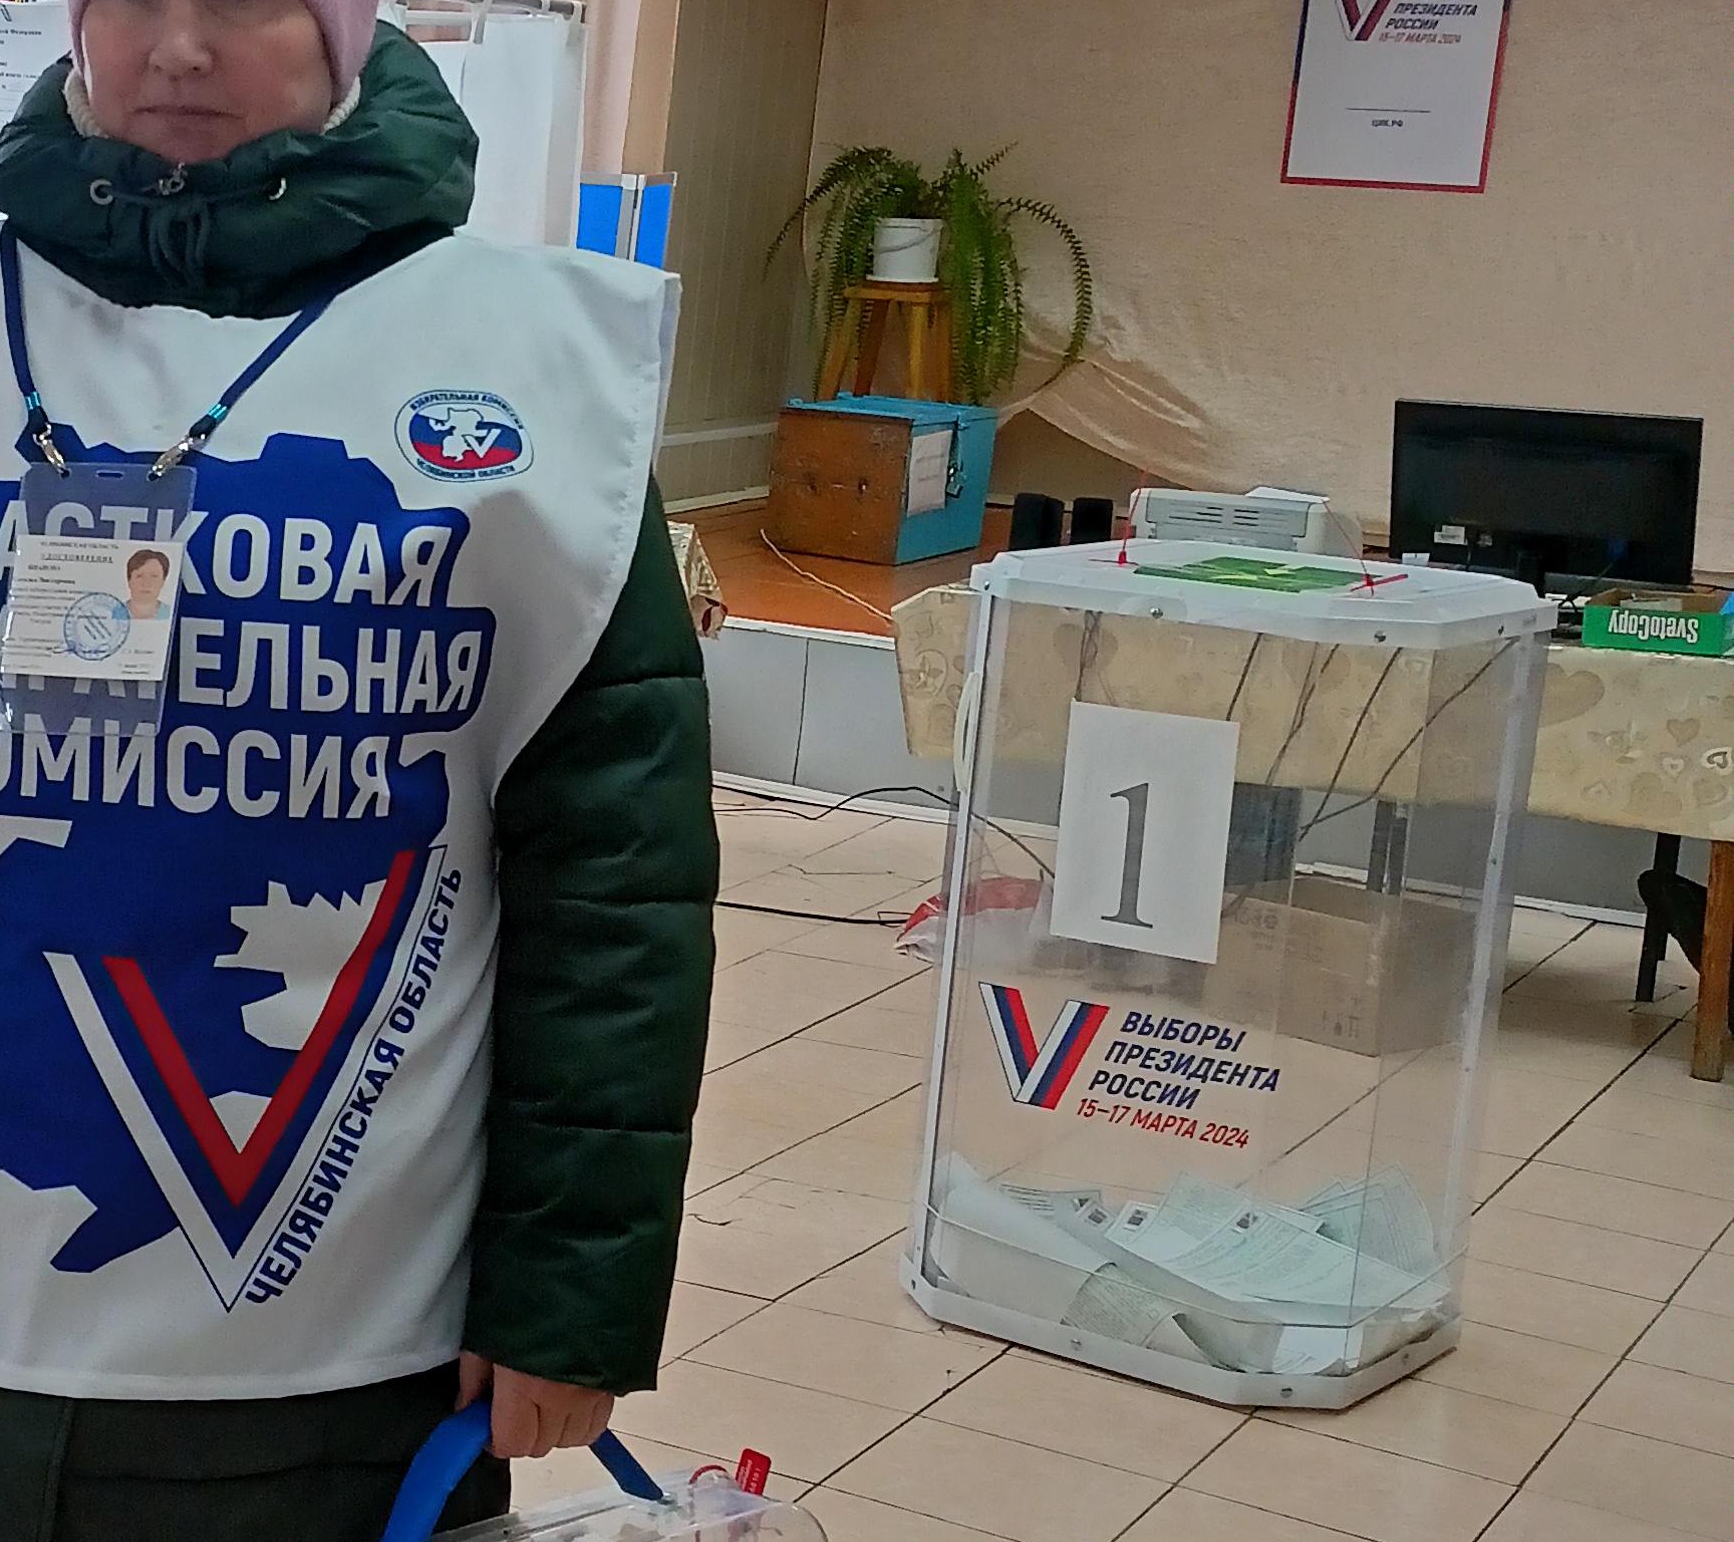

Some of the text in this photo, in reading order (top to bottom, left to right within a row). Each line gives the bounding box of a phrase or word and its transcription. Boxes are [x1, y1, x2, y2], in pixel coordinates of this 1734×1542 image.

[1385, 18, 1439, 30] РОССИИ
[1393, 3, 1478, 16] ПРЕЗИДЕНТА
[1405, 33, 1437, 44] МАРТА
[1608, 609, 1699, 644] SvetoCopy
[1100, 782, 1154, 929] 1
[1120, 1011, 1247, 1052] ВЫБОРЫ
[1104, 1041, 1281, 1092] ПРЕЗИДЕНТА
[245, 868, 463, 1306] ЧЕЛЯБИНСКАЯ ОБЛАСТЬ
[1088, 1070, 1201, 1110] РОССИИ
[1076, 1098, 1250, 1149] 15–17 МАРТА 2024
